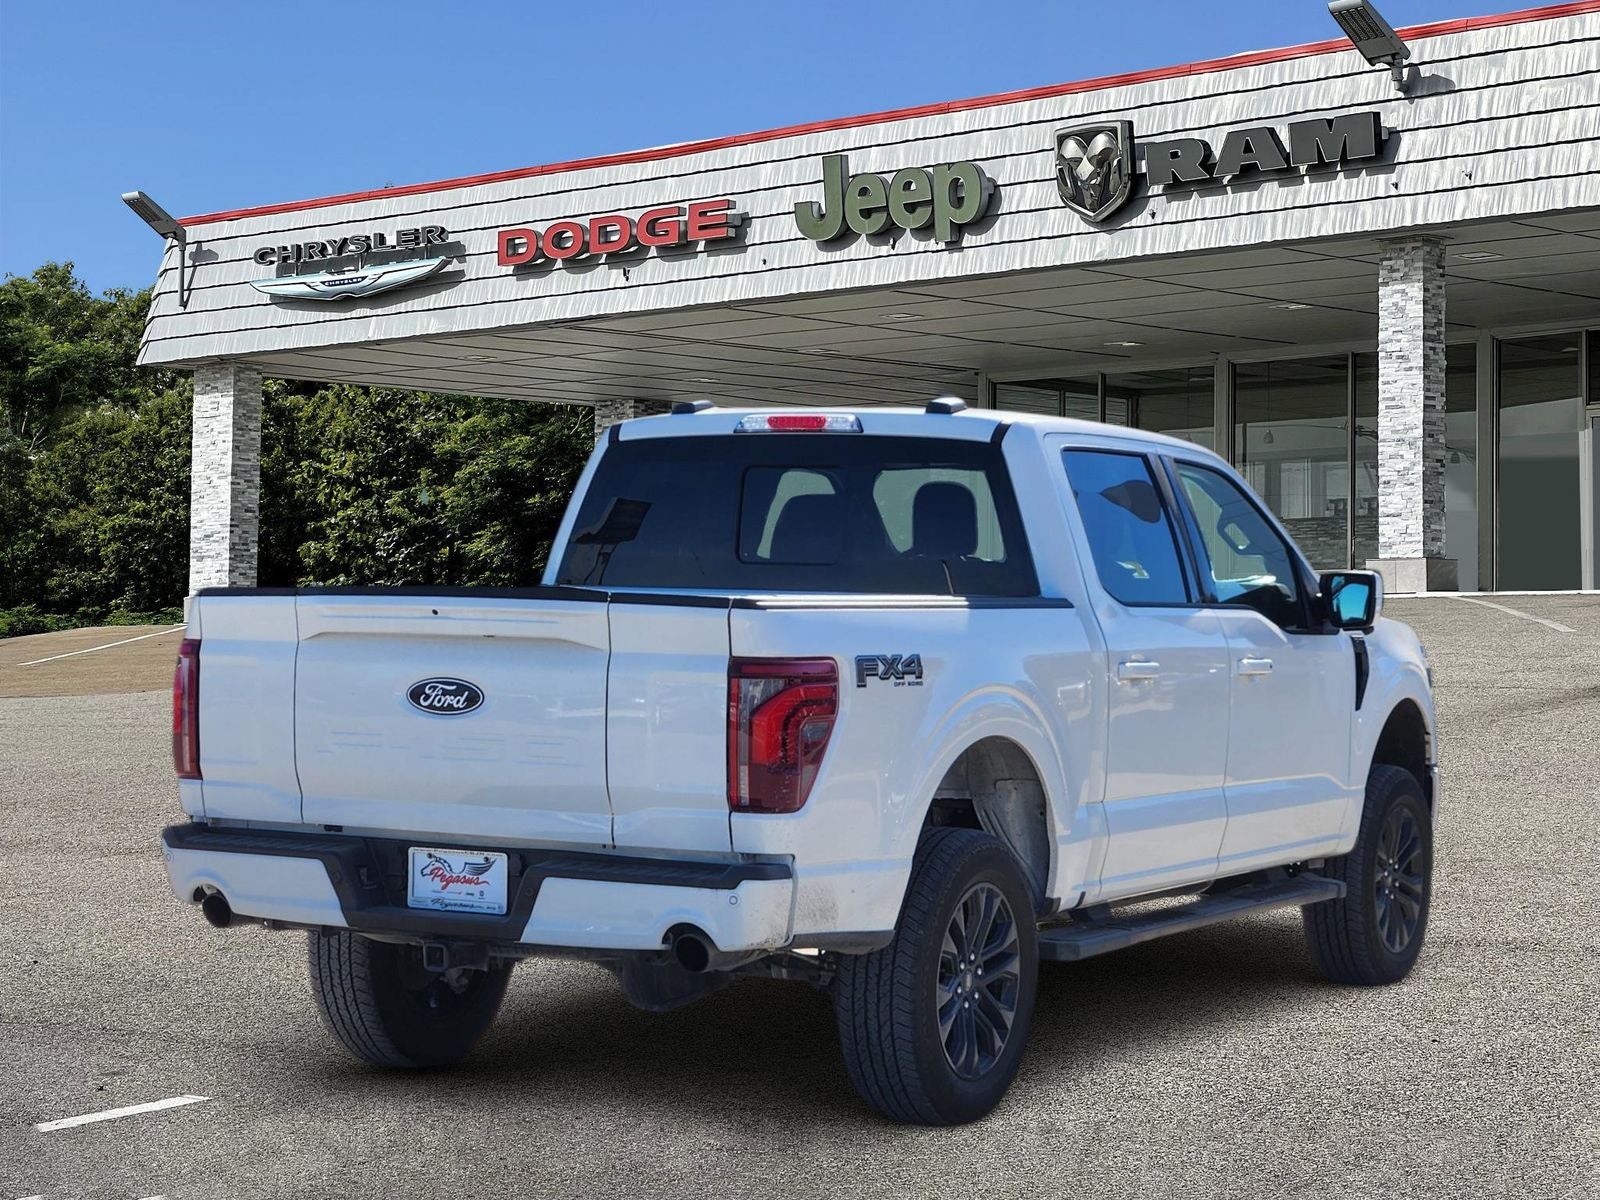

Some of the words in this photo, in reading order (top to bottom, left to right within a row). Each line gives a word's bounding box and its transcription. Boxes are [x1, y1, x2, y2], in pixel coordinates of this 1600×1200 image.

[1145, 112, 1380, 186] RAM
[795, 154, 987, 242] Jeep
[254, 225, 448, 266] CHRYSLER
[498, 199, 736, 266] DODGE
[855, 654, 923, 688] FX4
[419, 682, 469, 709] Ford
[429, 866, 490, 890] Pegasus
